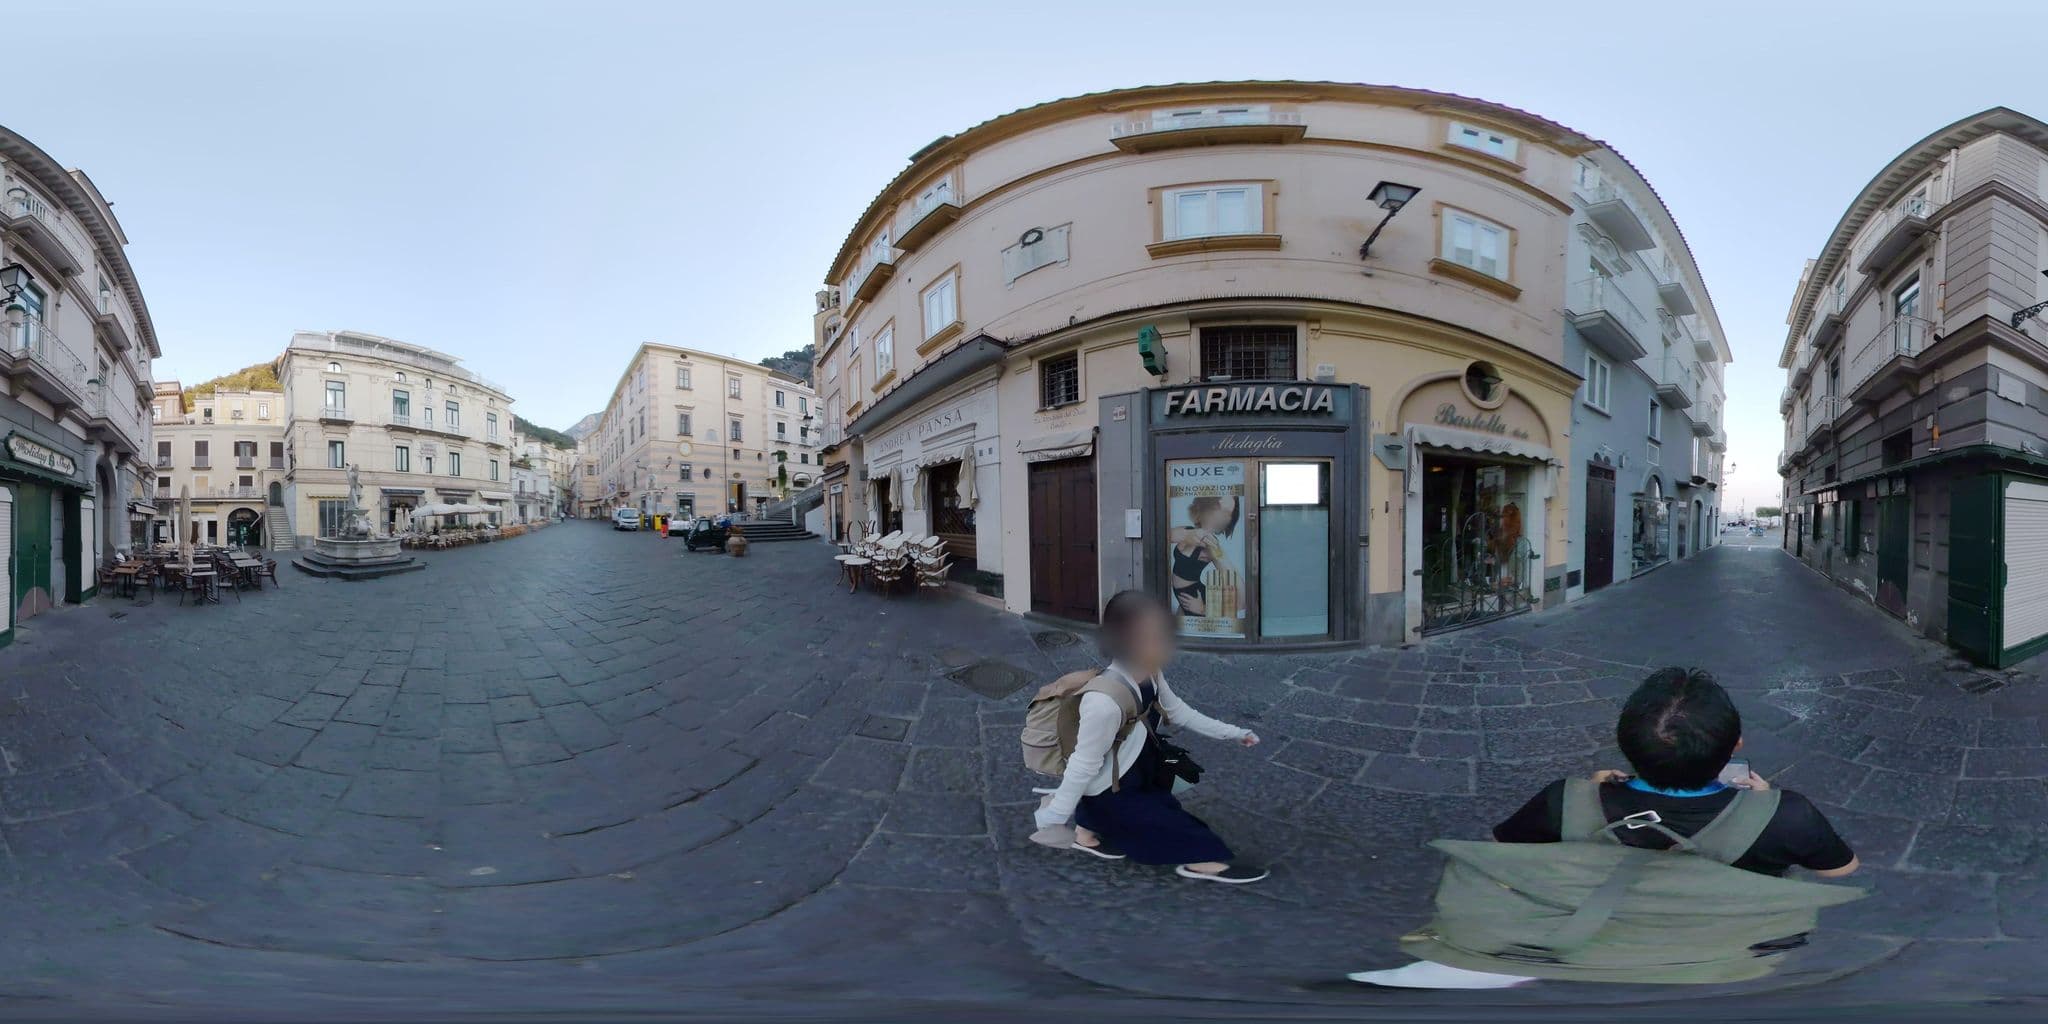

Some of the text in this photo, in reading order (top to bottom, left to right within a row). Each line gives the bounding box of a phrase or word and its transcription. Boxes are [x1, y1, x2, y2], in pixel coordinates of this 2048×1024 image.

[1164, 387, 1334, 416] FARMACIA
[881, 407, 962, 452] ANDREA PANSA
[14, 439, 47, 465] Holiday
[1212, 432, 1285, 454] Medaglia
[1174, 466, 1225, 477] NUXE
[1175, 484, 1242, 492] INNOVAZIONE
